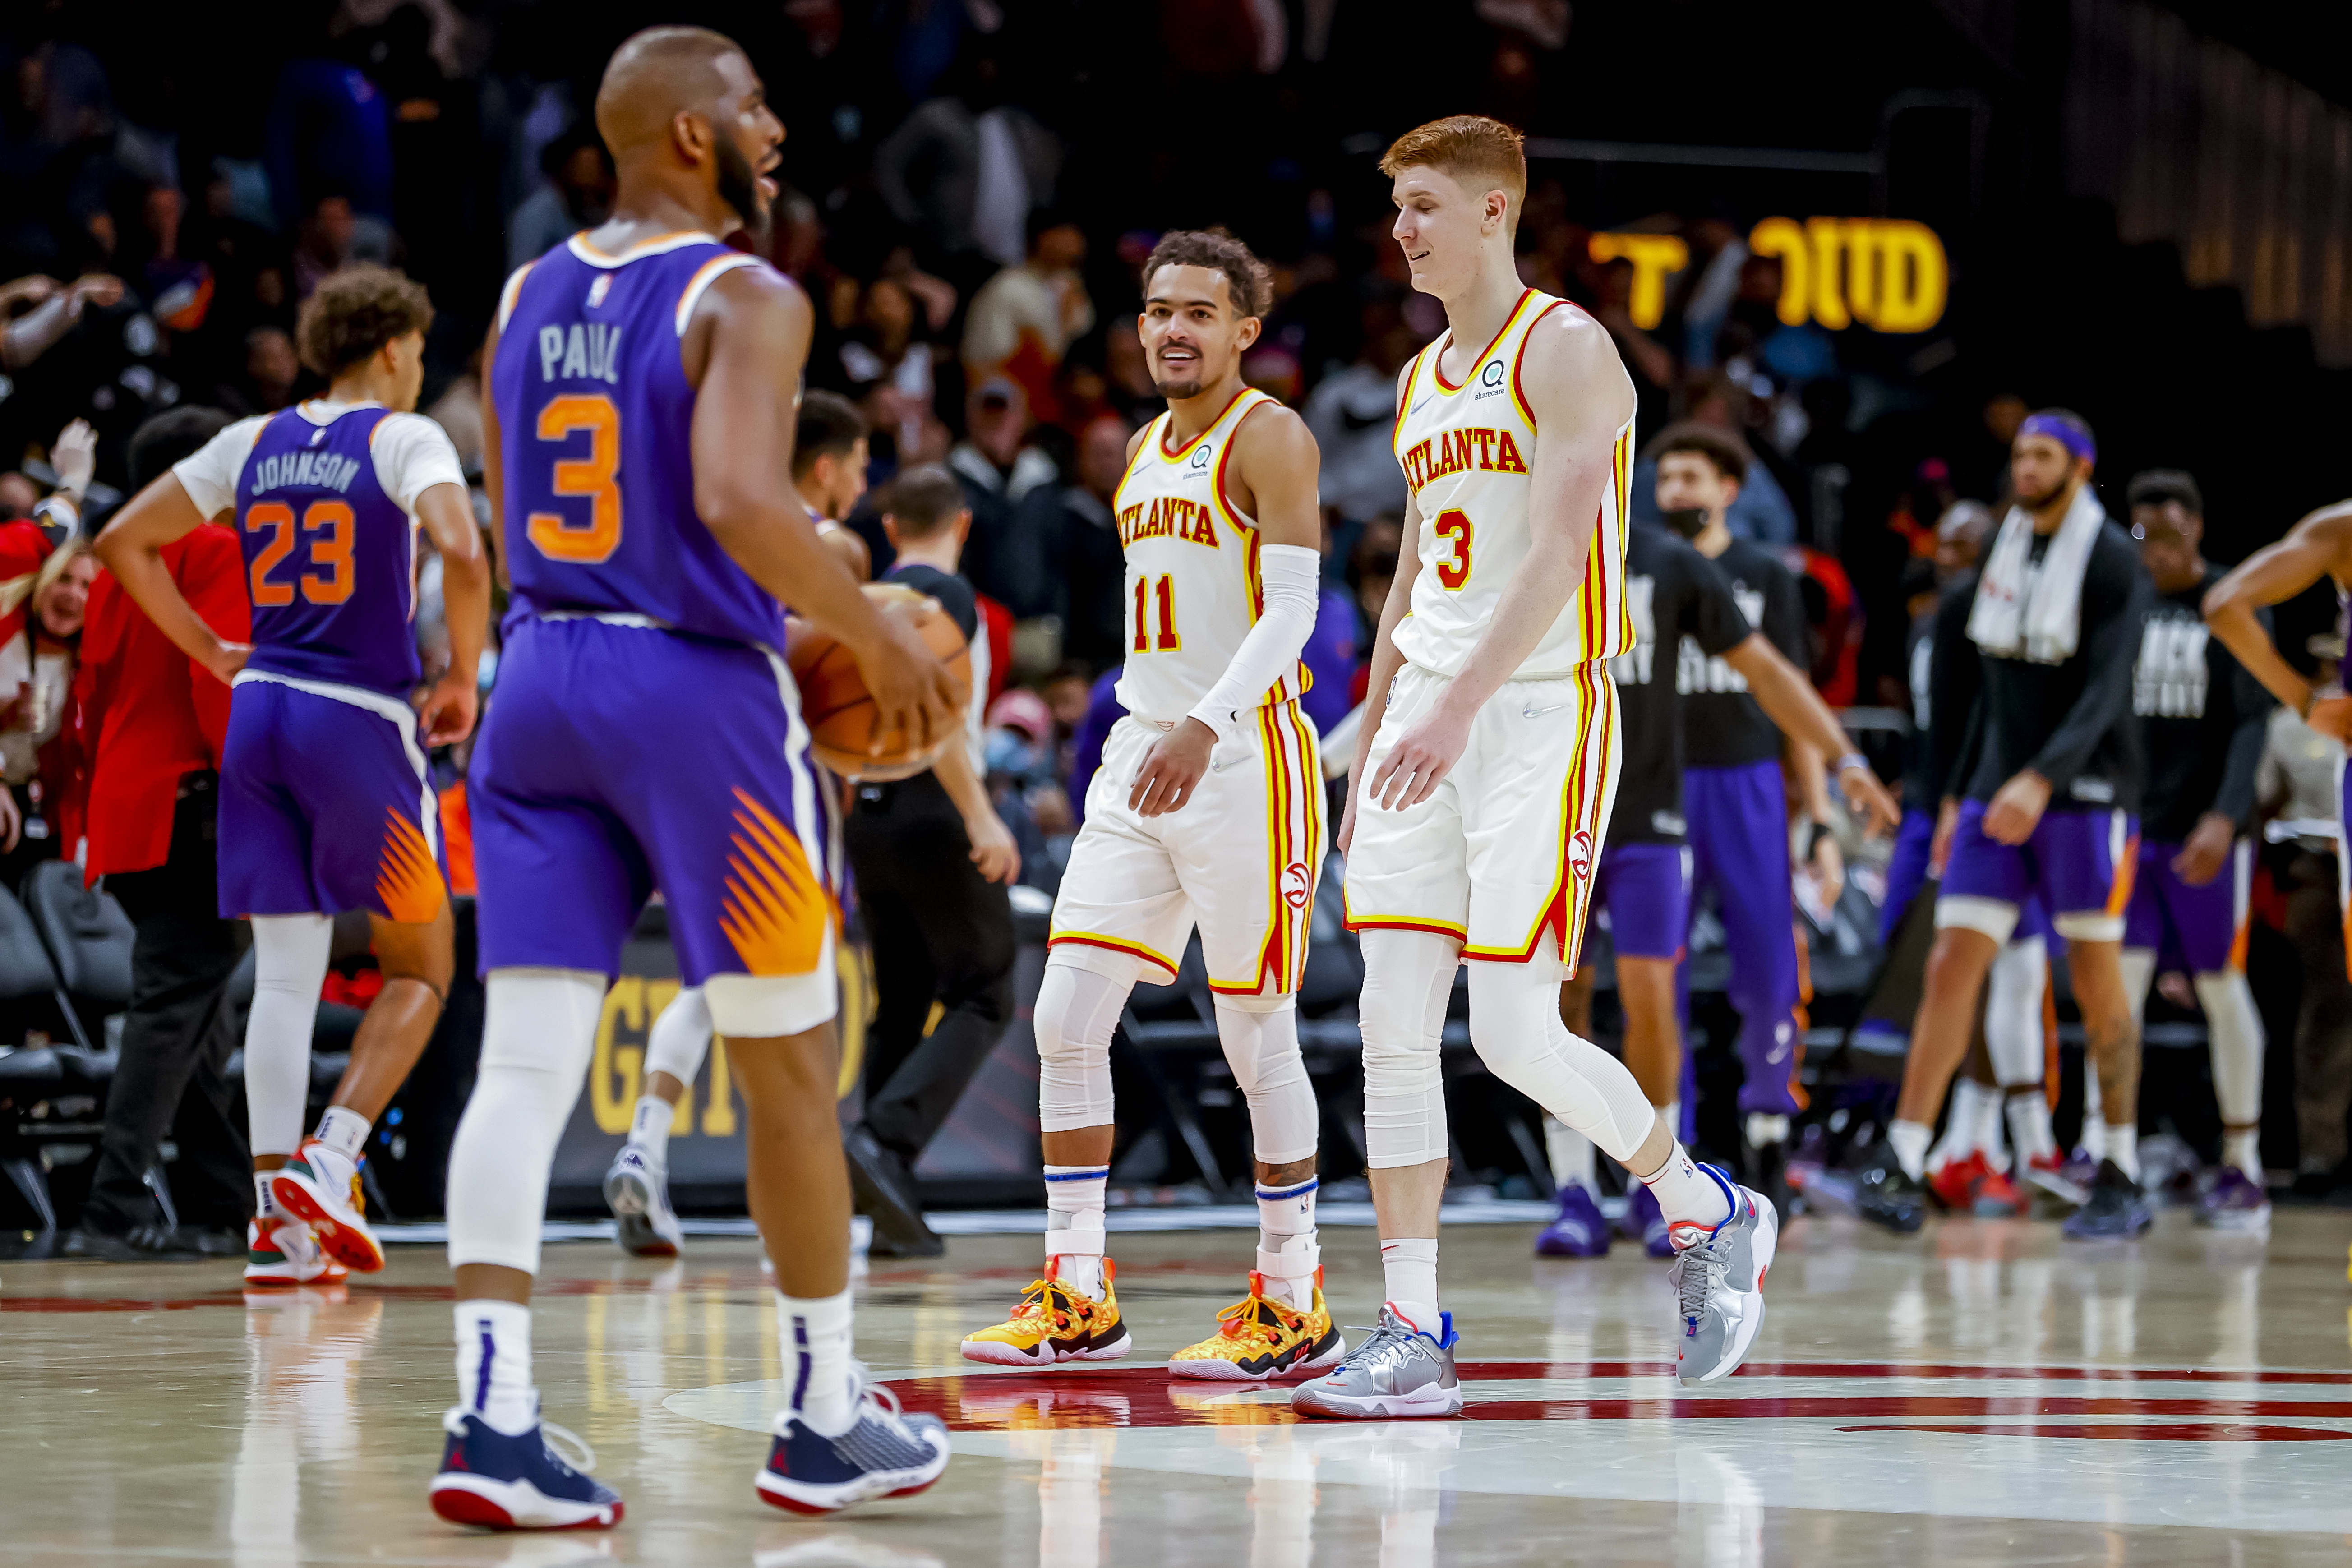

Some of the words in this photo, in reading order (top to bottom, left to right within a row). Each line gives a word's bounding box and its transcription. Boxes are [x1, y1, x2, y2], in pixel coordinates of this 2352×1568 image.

[540, 324, 622, 384] PAUL
[1475, 388, 1505, 401] sharecare
[251, 452, 360, 496] JOHNSON
[526, 393, 623, 564] 3
[1402, 427, 1529, 500] ATLANTA
[245, 500, 356, 607] 23
[1434, 507, 1474, 592] 3
[1133, 572, 1181, 654] 11
